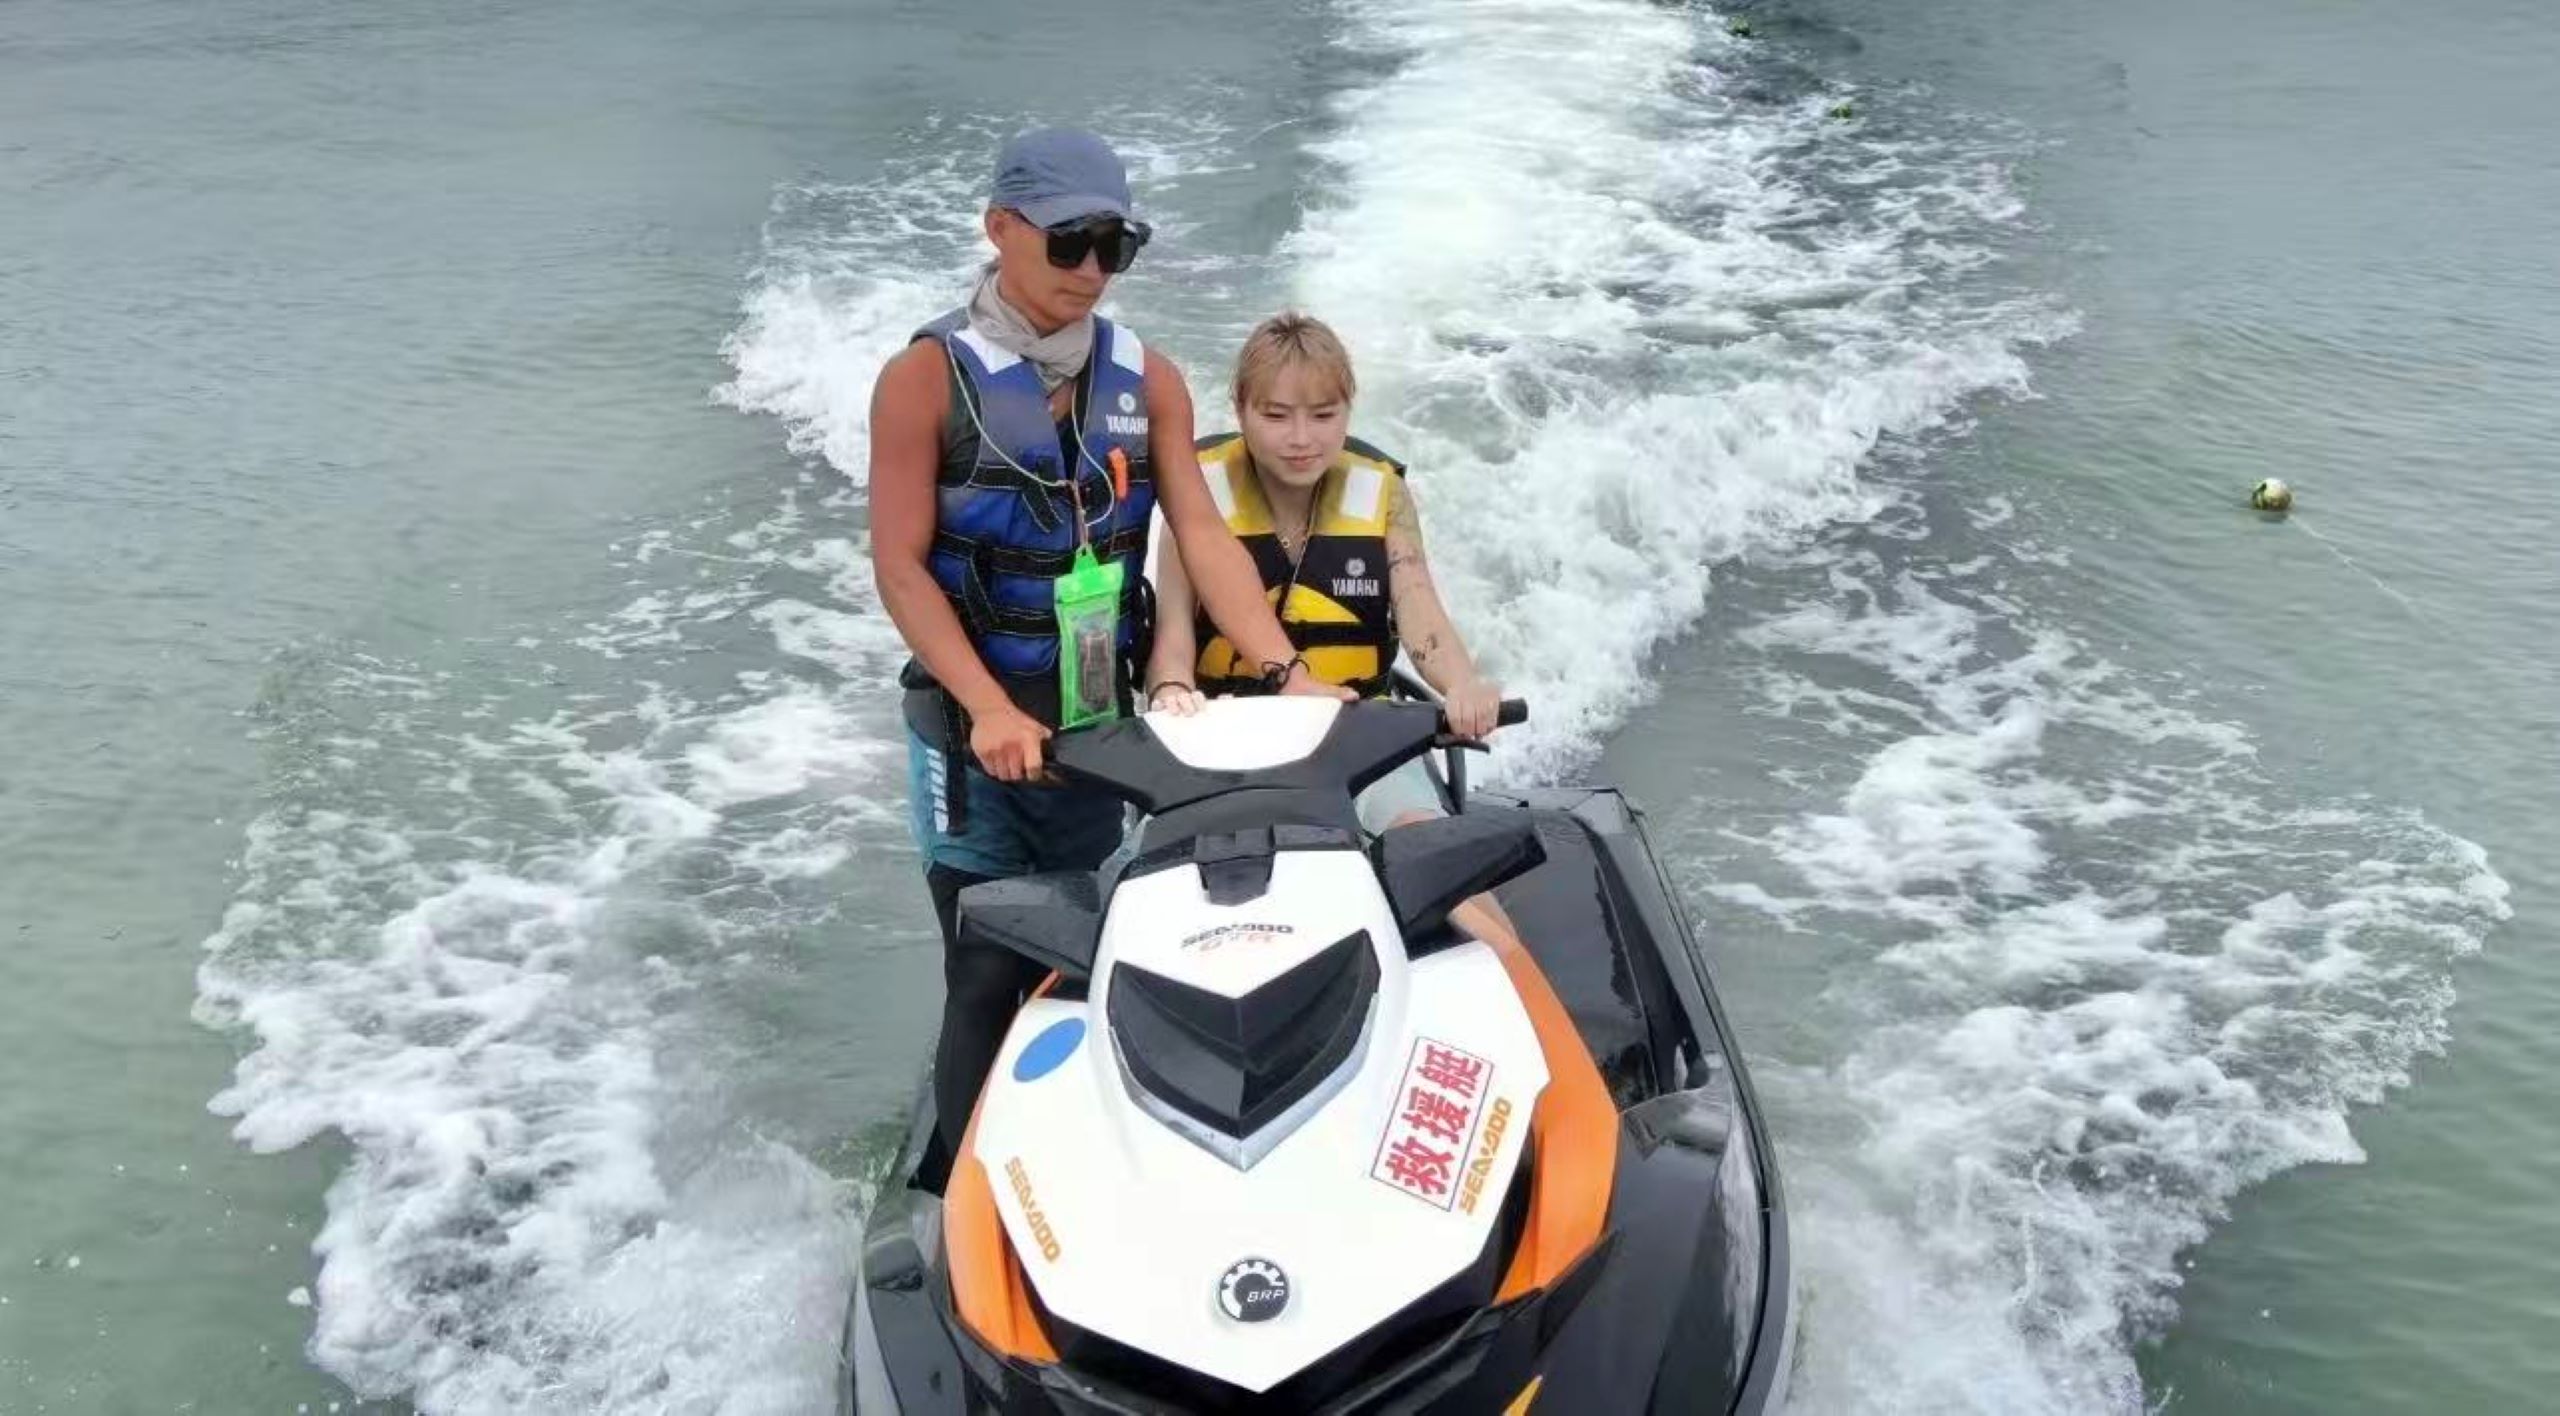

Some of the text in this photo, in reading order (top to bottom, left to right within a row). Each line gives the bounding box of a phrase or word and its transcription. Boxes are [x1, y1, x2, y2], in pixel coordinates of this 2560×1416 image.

[1105, 414, 1149, 435] YAMAH
[1332, 578, 1380, 596] YAMAHA
[1385, 1044, 1482, 1195] 救援艇
[1247, 1288, 1285, 1303] BRP
